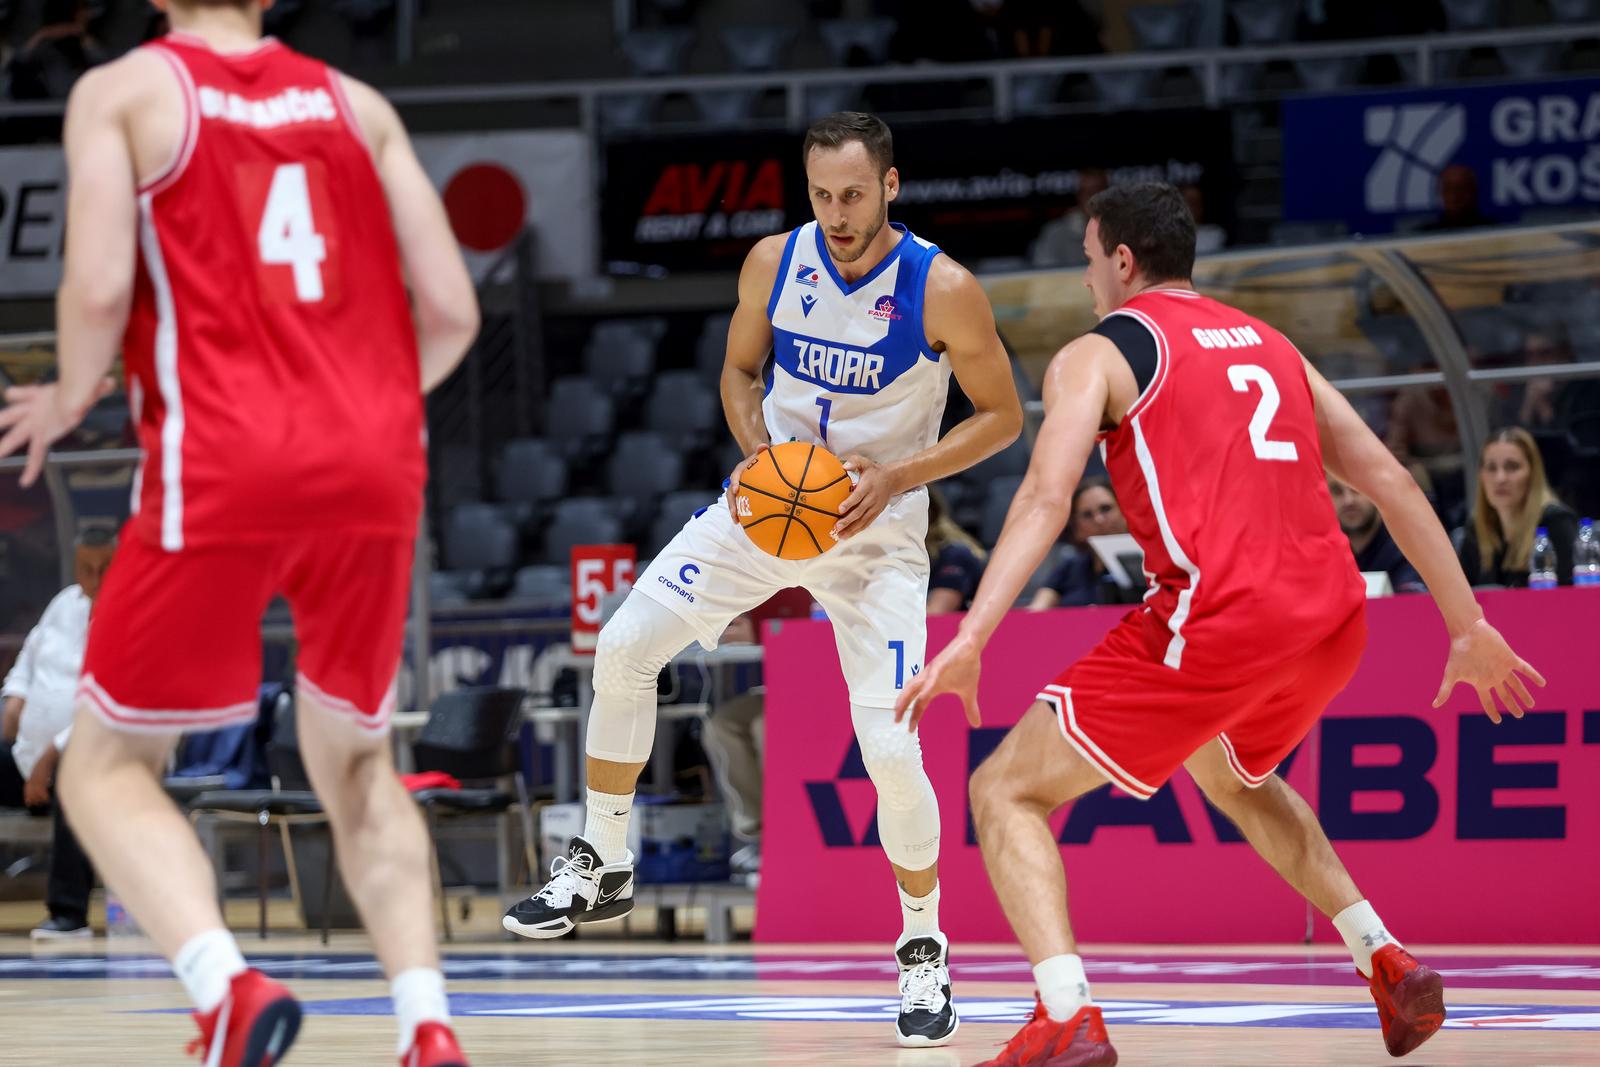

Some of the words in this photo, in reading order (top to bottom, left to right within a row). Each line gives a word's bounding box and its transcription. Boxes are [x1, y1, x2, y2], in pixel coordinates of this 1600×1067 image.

[642, 160, 786, 216] AVIA
[257, 162, 327, 302] 4
[1191, 325, 1263, 349] GULIN
[793, 338, 885, 389] ZADAR
[815, 396, 833, 444] 1
[1227, 364, 1299, 462] 2
[657, 575, 695, 603] cromaris
[887, 640, 904, 690] 1
